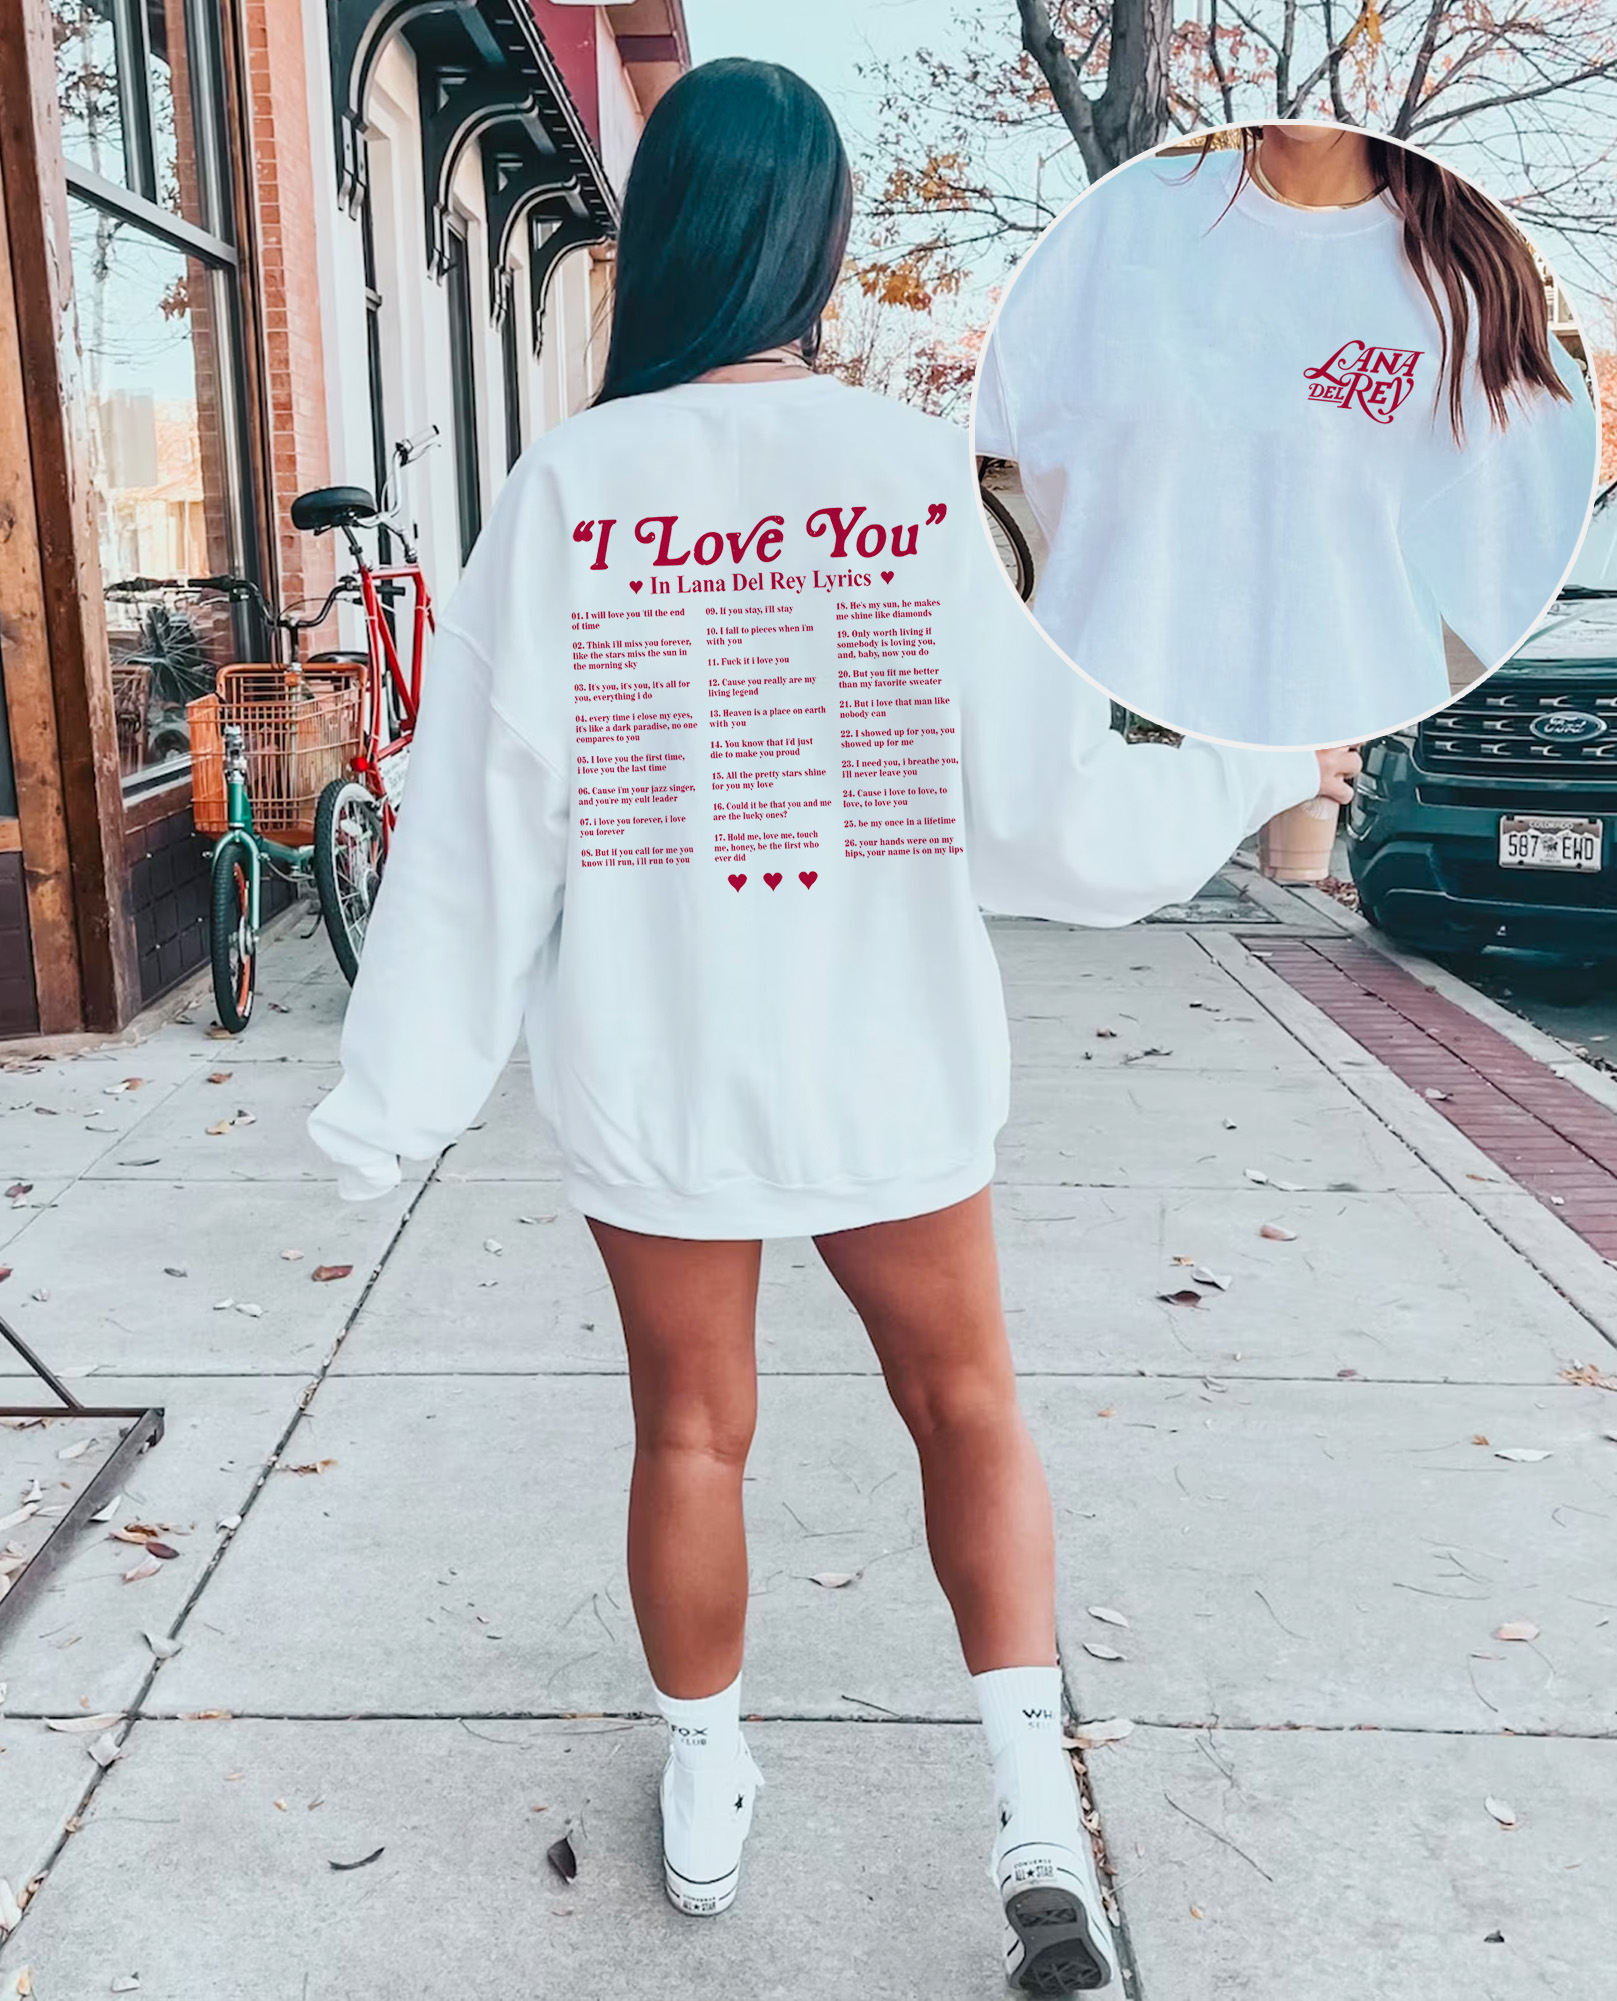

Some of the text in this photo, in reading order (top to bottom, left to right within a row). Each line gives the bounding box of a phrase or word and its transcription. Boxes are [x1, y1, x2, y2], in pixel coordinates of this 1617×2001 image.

[1303, 340, 1425, 384] LANA
[1308, 383, 1345, 400] DEL
[635, 515, 785, 567] Love
[805, 503, 948, 559] You”
[650, 569, 872, 594] In Lana Del Rey Lyrics
[836, 602, 848, 610] 18.
[868, 602, 881, 610] my
[902, 600, 912, 608] he
[914, 599, 941, 607] makes
[705, 607, 718, 615] 09.
[720, 607, 726, 615] If
[728, 608, 743, 617] you
[745, 607, 763, 615] stay,
[777, 605, 793, 614] stay
[850, 612, 873, 620] shine
[875, 611, 891, 619] like
[892, 609, 932, 618] diamonds
[837, 627, 932, 639] 19. Only worth living if
[572, 641, 585, 650] 02.
[586, 640, 611, 649] Think
[624, 640, 643, 648] miss
[644, 640, 659, 649] you
[660, 638, 692, 647] forever,
[837, 638, 936, 649] somebody is loving you,
[573, 652, 588, 660] like
[590, 651, 604, 659] the
[627, 650, 646, 658] miss
[647, 649, 661, 657] the
[679, 648, 687, 656] in
[837, 650, 856, 659] and,
[858, 650, 880, 659] baby,
[901, 650, 916, 658] you
[918, 648, 929, 656] do
[573, 660, 637, 670] the morning sky
[838, 670, 851, 678] 20.
[853, 670, 868, 678] But
[870, 671, 885, 679] you
[887, 668, 896, 677] fit
[709, 678, 720, 687] 12.
[721, 678, 746, 686] Cause
[747, 679, 762, 687] you
[764, 676, 786, 686] really
[839, 680, 858, 689] than
[860, 681, 872, 689] my
[874, 679, 907, 687] favorite
[708, 687, 759, 698] living legend
[575, 712, 693, 724] 04. every time i close my eyes,
[588, 724, 604, 733] like
[612, 723, 631, 732] dark
[633, 722, 670, 733] paradise,
[1543, 716, 1587, 733] Ford
[576, 736, 615, 745] compares
[626, 735, 640, 743] you
[841, 757, 959, 768] 23. I need you, i breathe you,
[712, 772, 724, 780] 15.
[726, 771, 738, 779] All
[739, 771, 753, 779] the
[755, 771, 779, 780] pretty
[804, 768, 826, 776] shine
[879, 769, 901, 777] leave
[903, 769, 918, 778] you
[578, 787, 591, 795] 06.
[592, 787, 616, 795] Cause
[631, 787, 650, 795] your
[651, 785, 667, 794] jazz
[669, 784, 696, 793] singer,
[712, 780, 774, 792] for you my love
[578, 797, 594, 806] and
[621, 797, 632, 806] my
[634, 795, 650, 803] cult
[652, 794, 678, 803] leader
[1528, 820, 1574, 829] COLORADO
[715, 833, 726, 842] 17.
[727, 833, 745, 841] Hold
[763, 832, 779, 840] love
[796, 830, 818, 839] touch
[730, 843, 756, 853] honey,
[757, 842, 767, 850] be
[769, 842, 782, 850] the
[784, 841, 801, 849] first
[803, 840, 820, 848] who
[1508, 834, 1540, 857] 587
[733, 853, 746, 862] did
